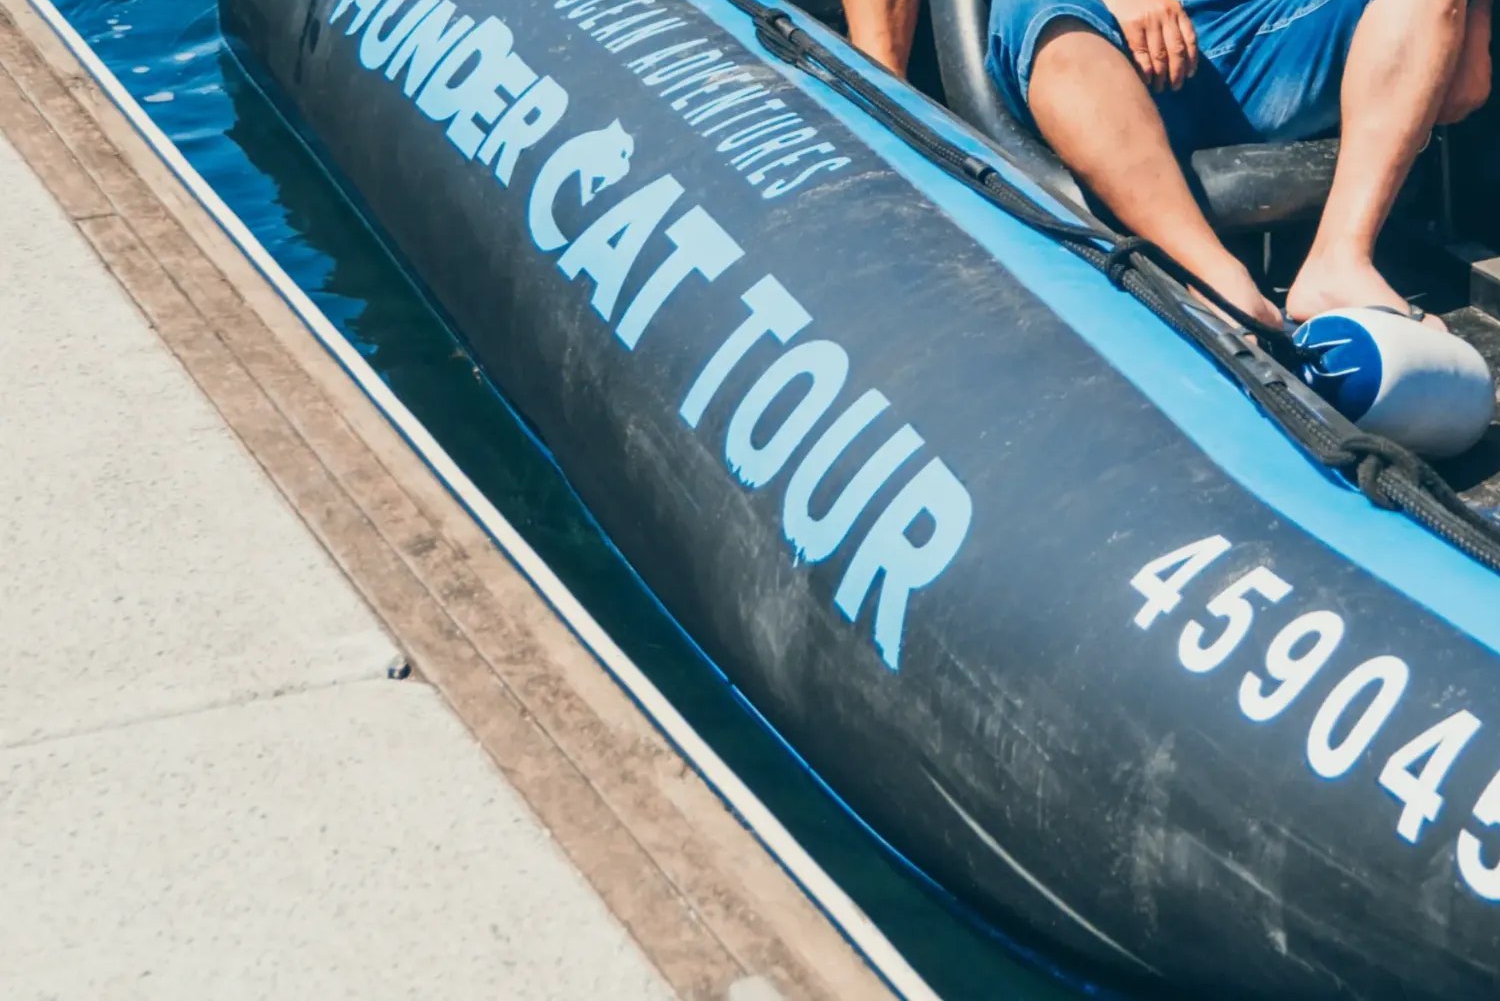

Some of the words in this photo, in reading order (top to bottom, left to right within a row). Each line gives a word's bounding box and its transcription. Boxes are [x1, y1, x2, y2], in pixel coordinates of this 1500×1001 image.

[624, 37, 852, 199] ADVENTURES
[529, 118, 745, 351] CAT
[679, 274, 973, 672] TOUR
